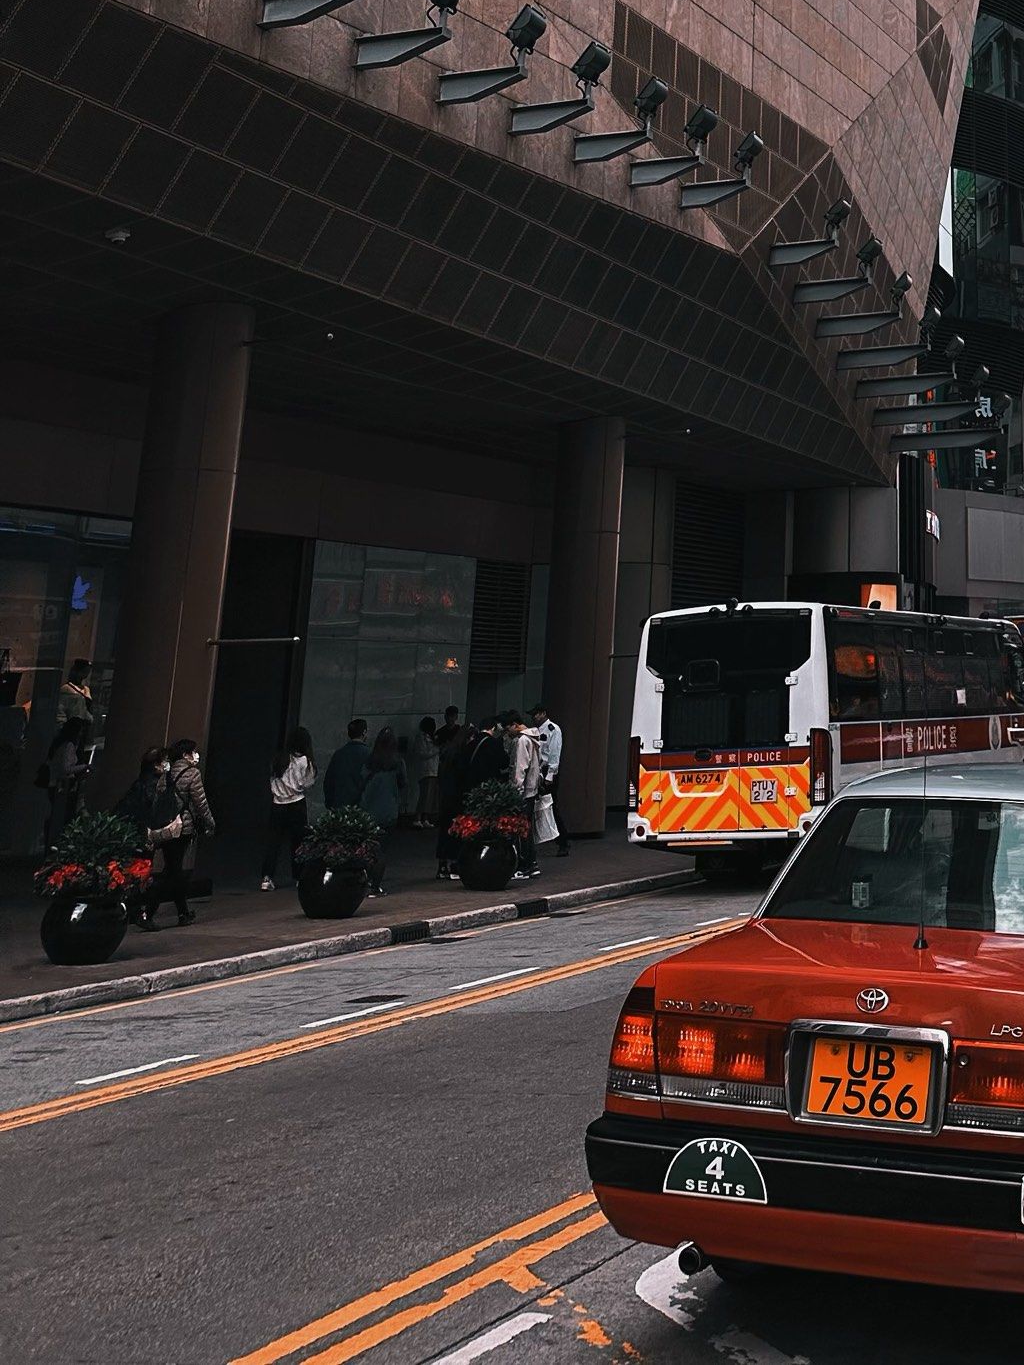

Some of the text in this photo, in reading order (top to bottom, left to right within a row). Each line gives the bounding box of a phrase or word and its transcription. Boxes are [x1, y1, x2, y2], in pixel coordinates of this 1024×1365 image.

[917, 725, 947, 752] POLICE
[747, 751, 781, 762] POLICE
[680, 772, 722, 784] AM 6274
[990, 1024, 1024, 1038] LPG
[846, 1044, 896, 1081] UB
[819, 1076, 918, 1121] 7566
[697, 1140, 738, 1158] TAXI
[705, 1156, 725, 1180] 4
[685, 1178, 746, 1196] SEATS
